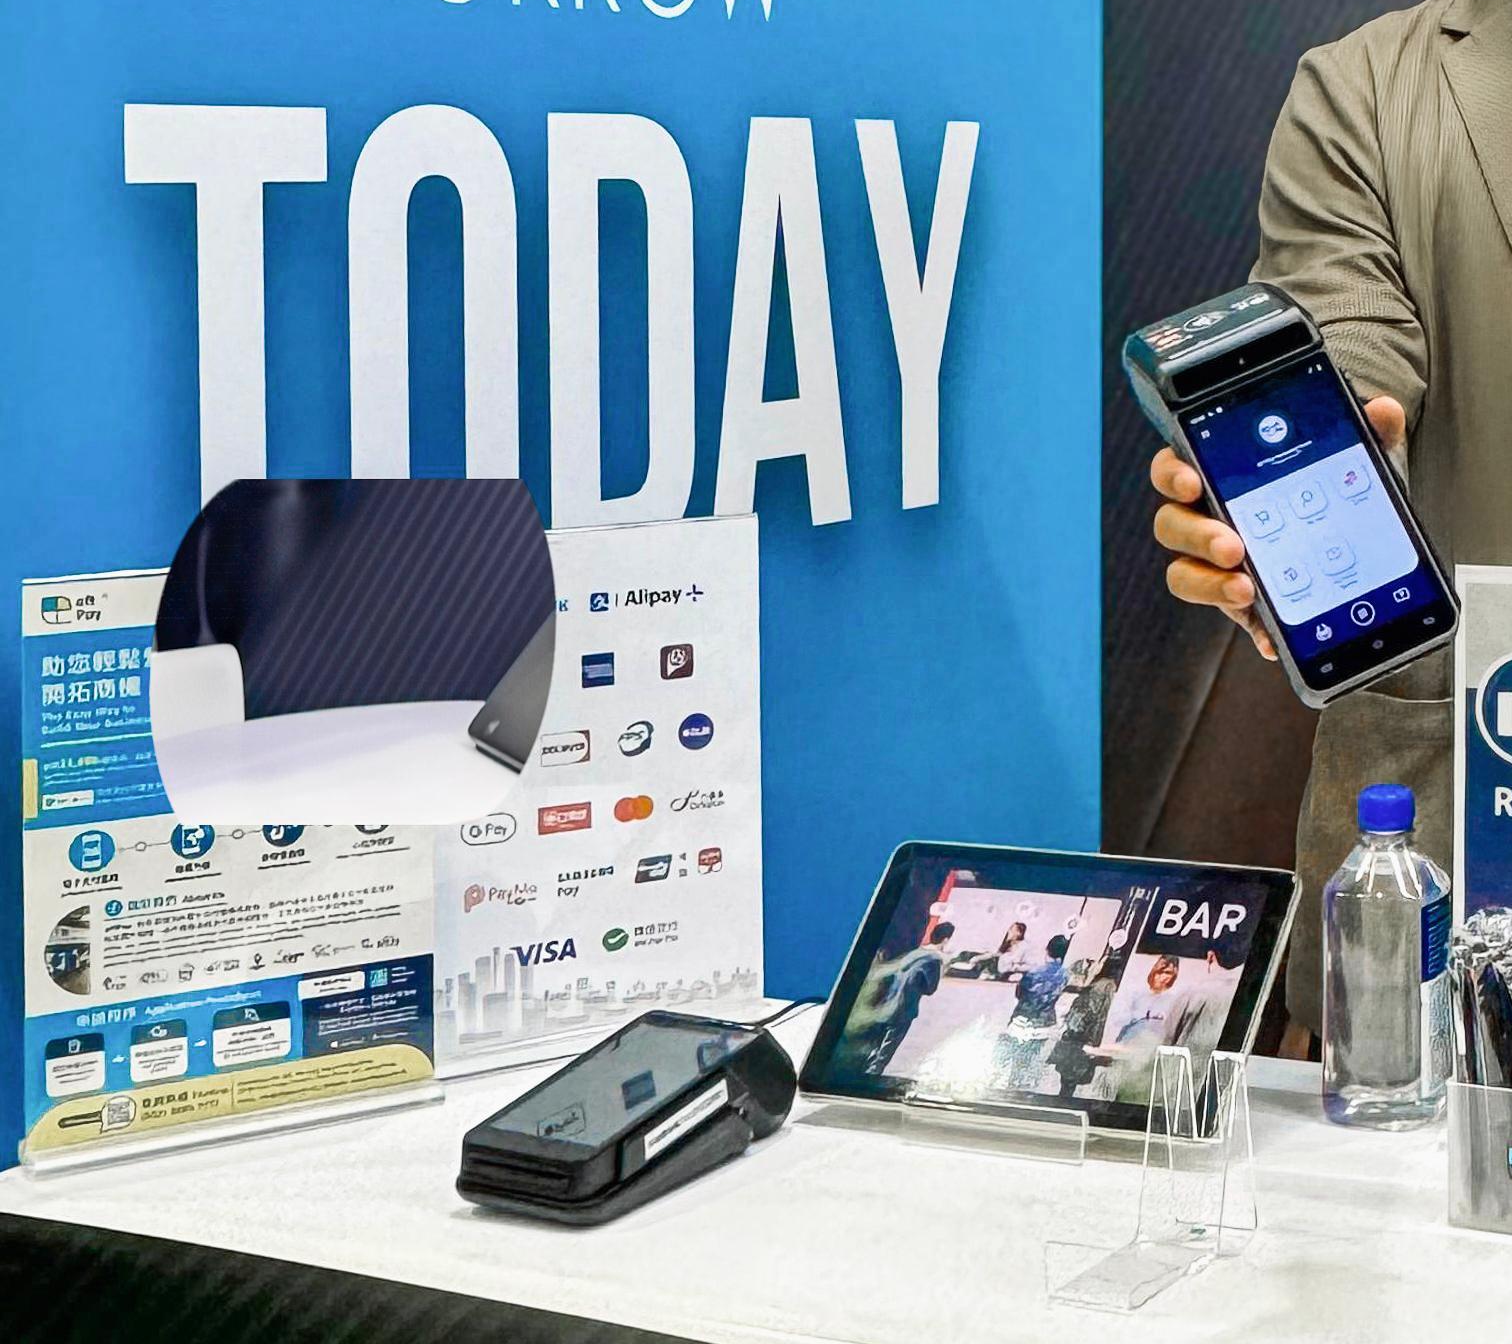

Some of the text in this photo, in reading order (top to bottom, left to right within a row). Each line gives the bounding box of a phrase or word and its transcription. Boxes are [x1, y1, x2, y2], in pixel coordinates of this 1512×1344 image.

[123, 102, 979, 528] TODAY
[1155, 898, 1248, 940] BAR
[510, 937, 577, 967] VISA
